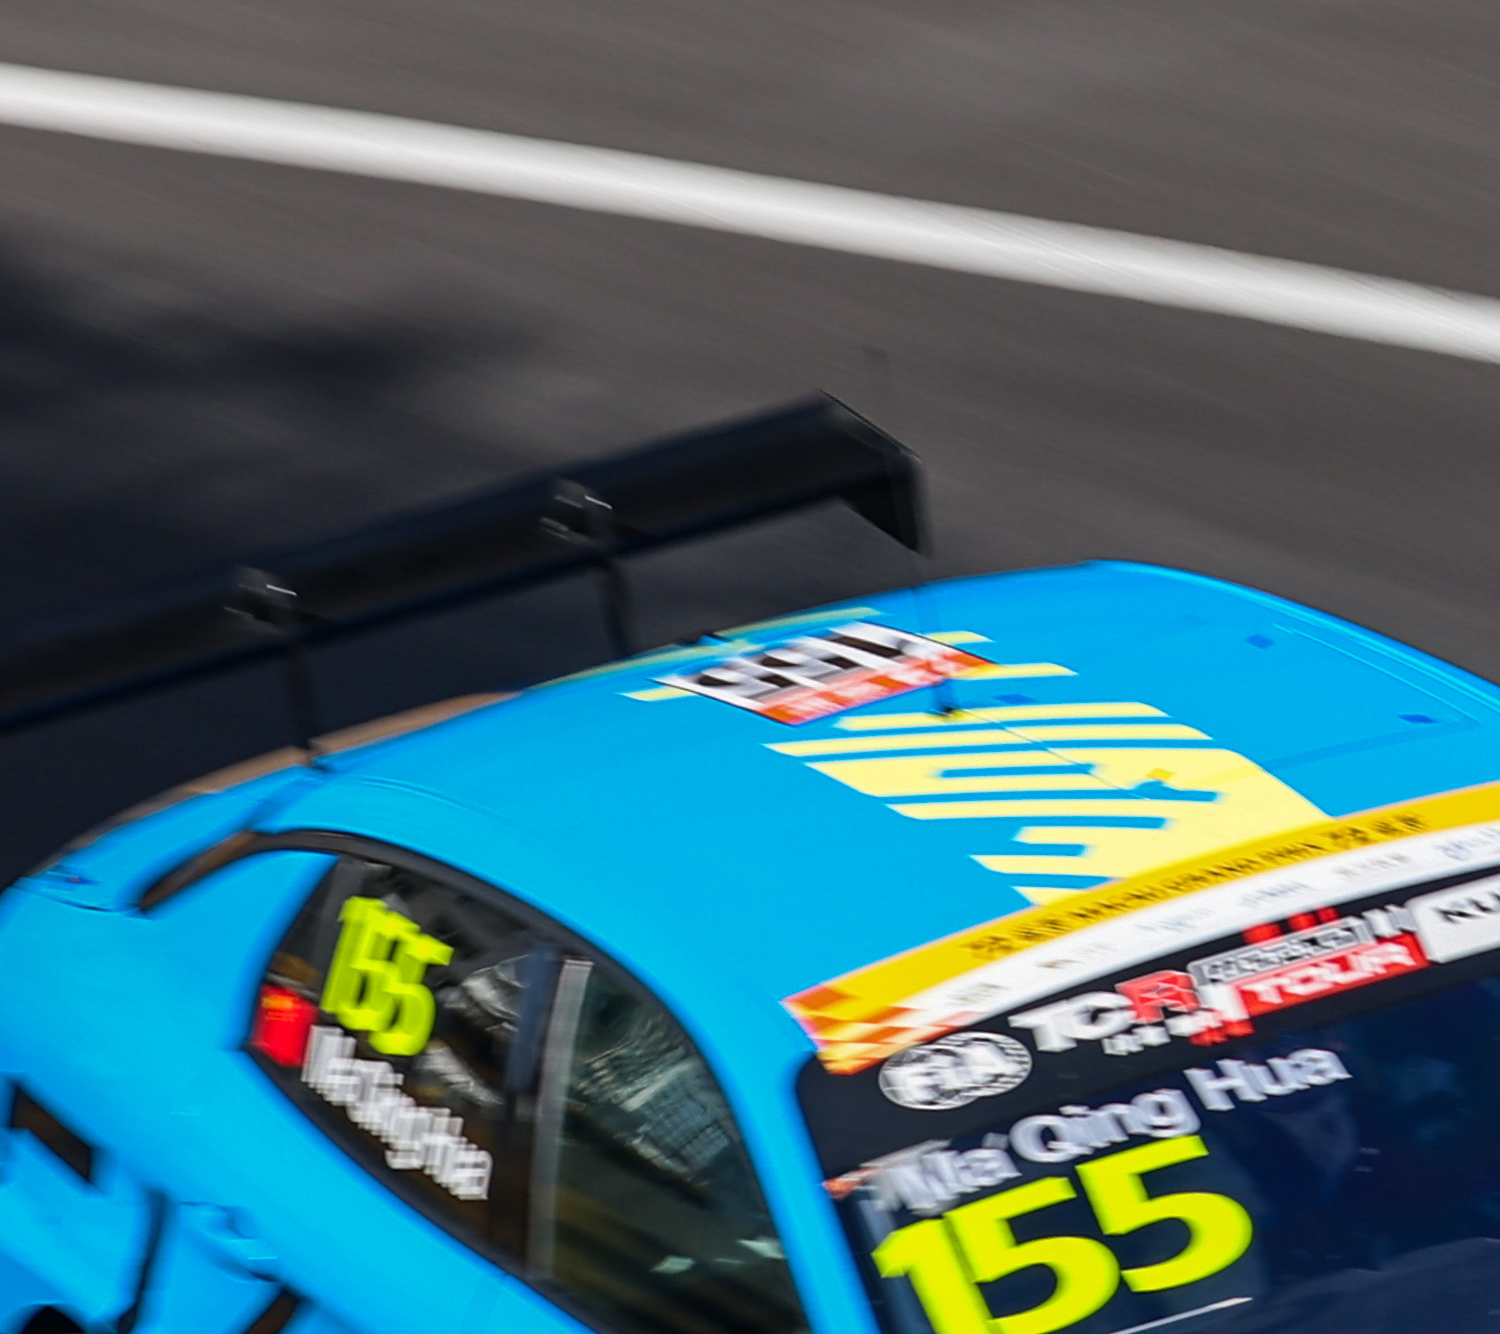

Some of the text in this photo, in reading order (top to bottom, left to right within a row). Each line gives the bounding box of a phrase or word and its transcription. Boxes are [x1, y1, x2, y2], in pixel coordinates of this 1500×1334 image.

[320, 896, 454, 1055] 155
[1008, 970, 1200, 1055] TCR
[1241, 938, 1416, 1004] TOUR
[1010, 1088, 1201, 1163] Qing
[1184, 1047, 1353, 1111] Hua
